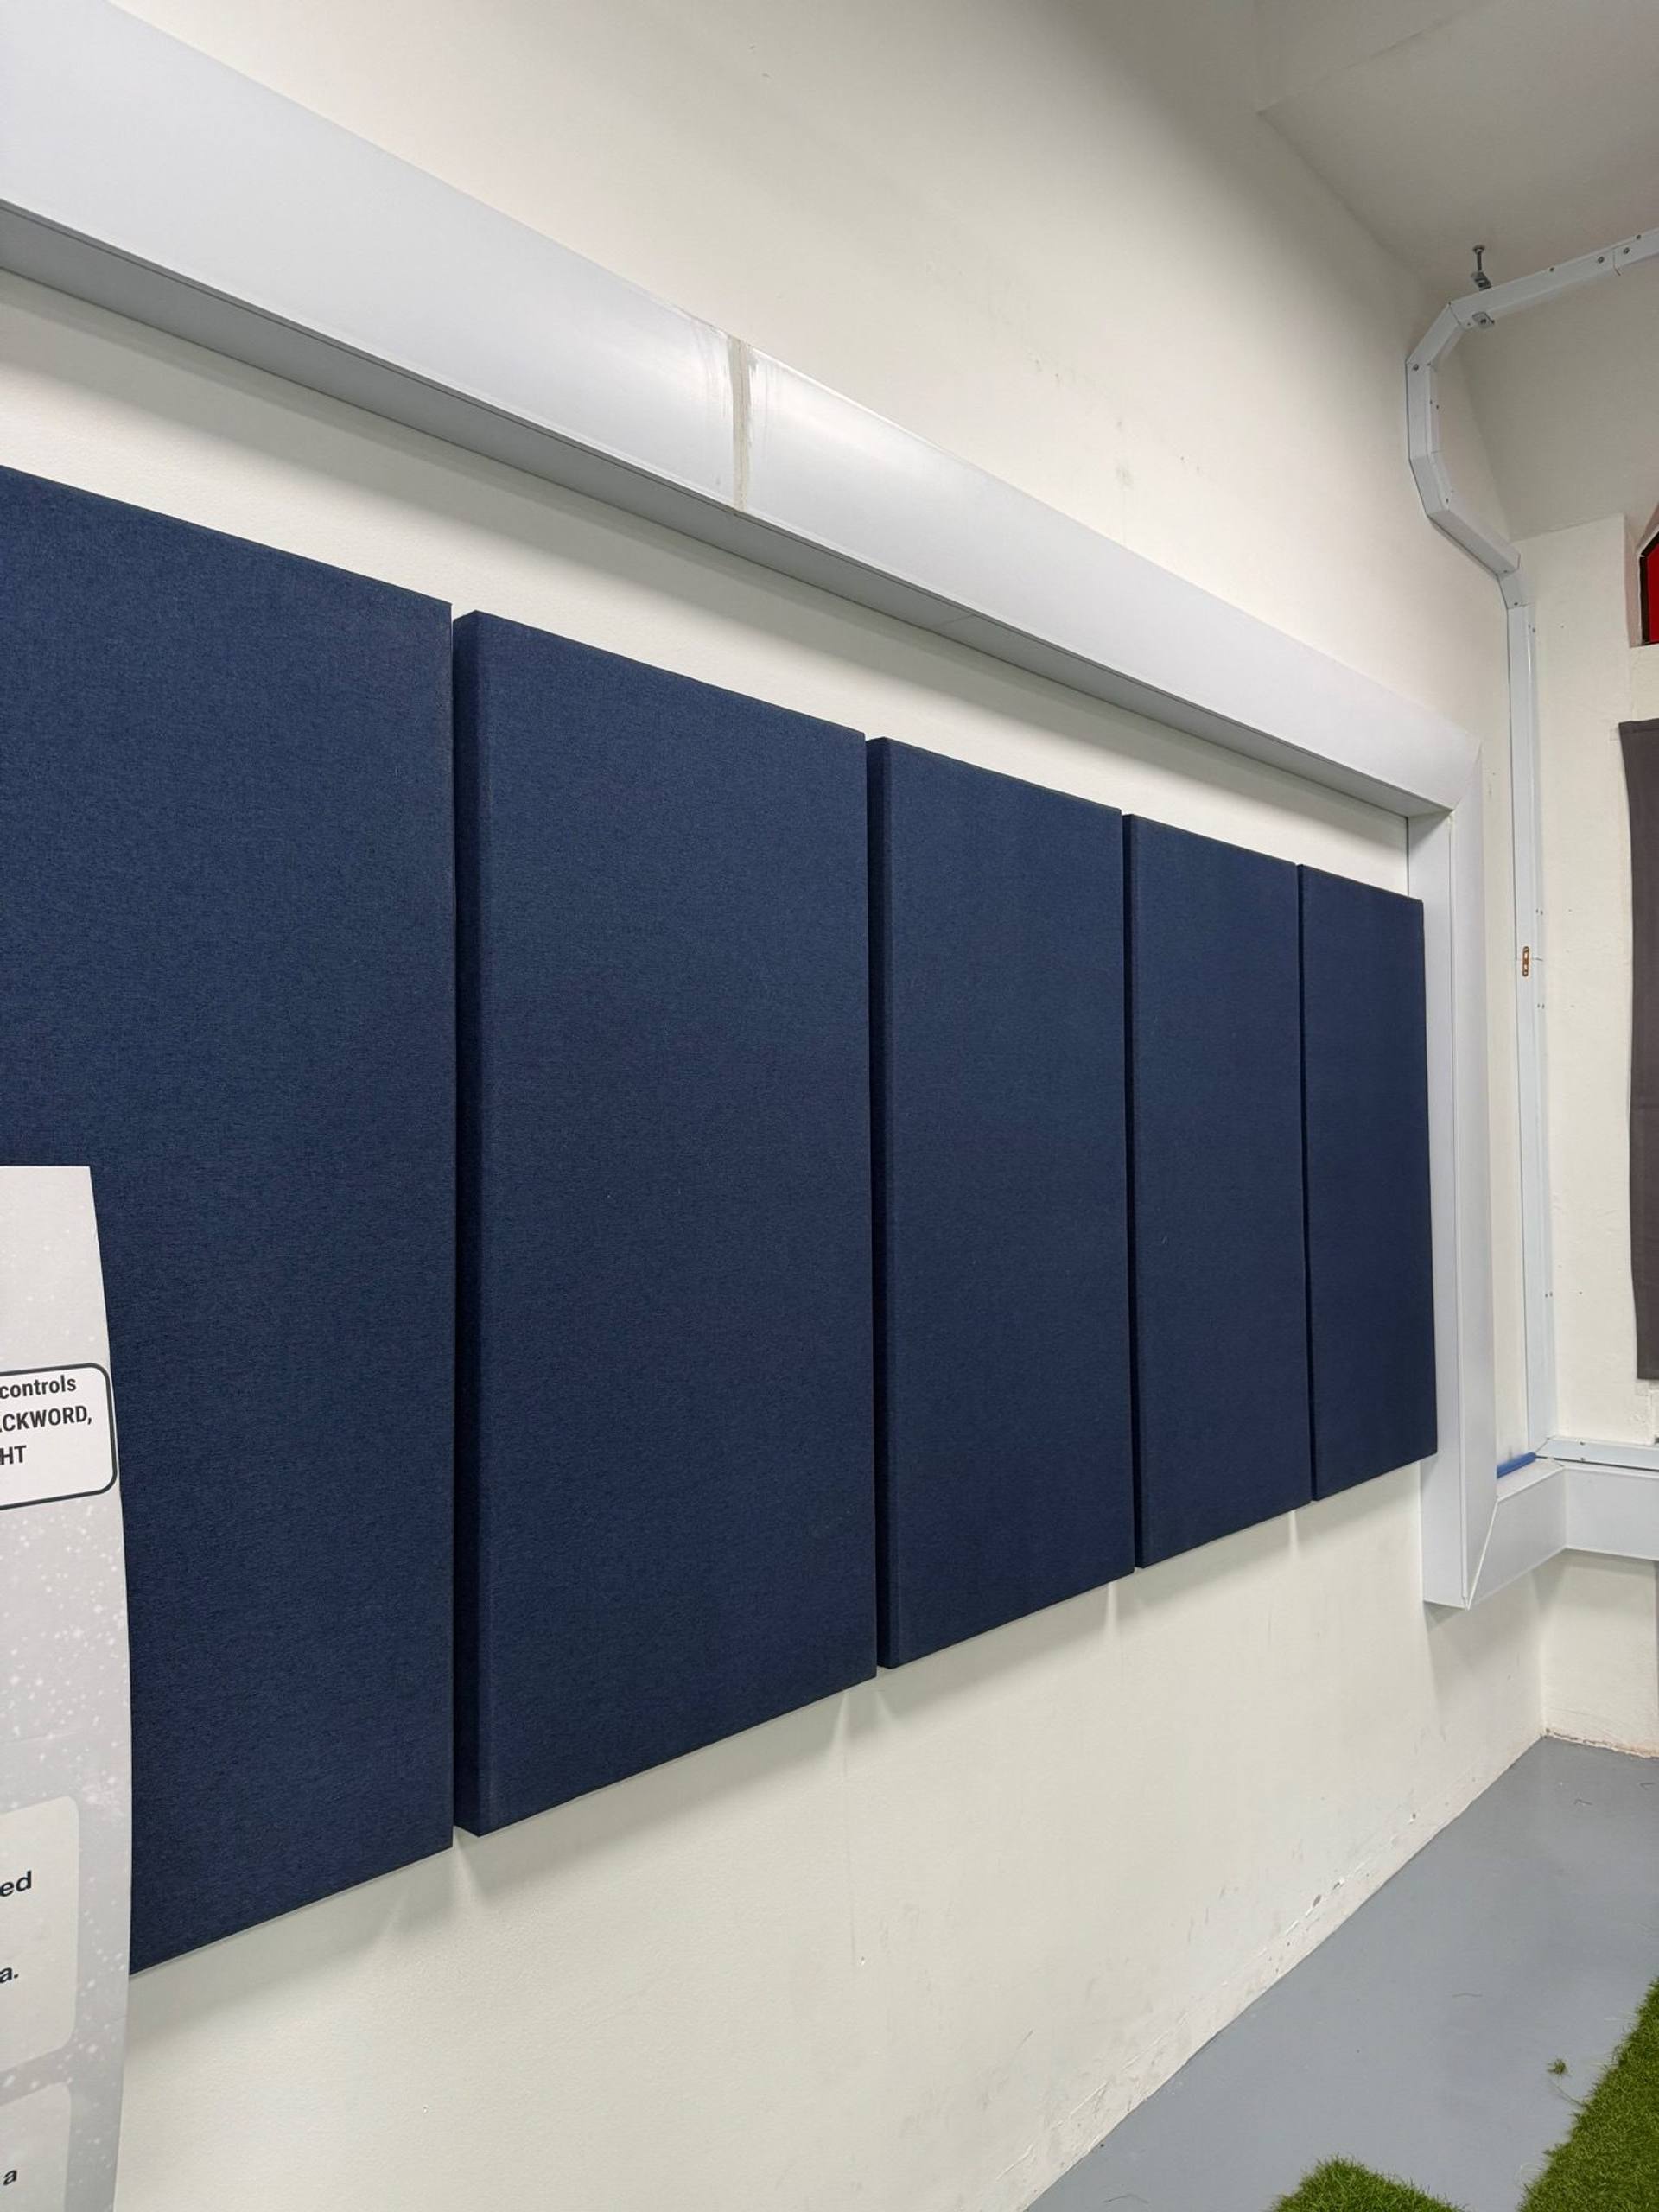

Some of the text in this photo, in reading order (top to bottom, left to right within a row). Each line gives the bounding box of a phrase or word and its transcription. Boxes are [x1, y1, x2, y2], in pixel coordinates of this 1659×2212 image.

[0, 1375, 76, 1399] controls
[0, 1405, 92, 1432] CKWORD,
[0, 1870, 32, 1897] ed
[3, 2169, 17, 2186] a
